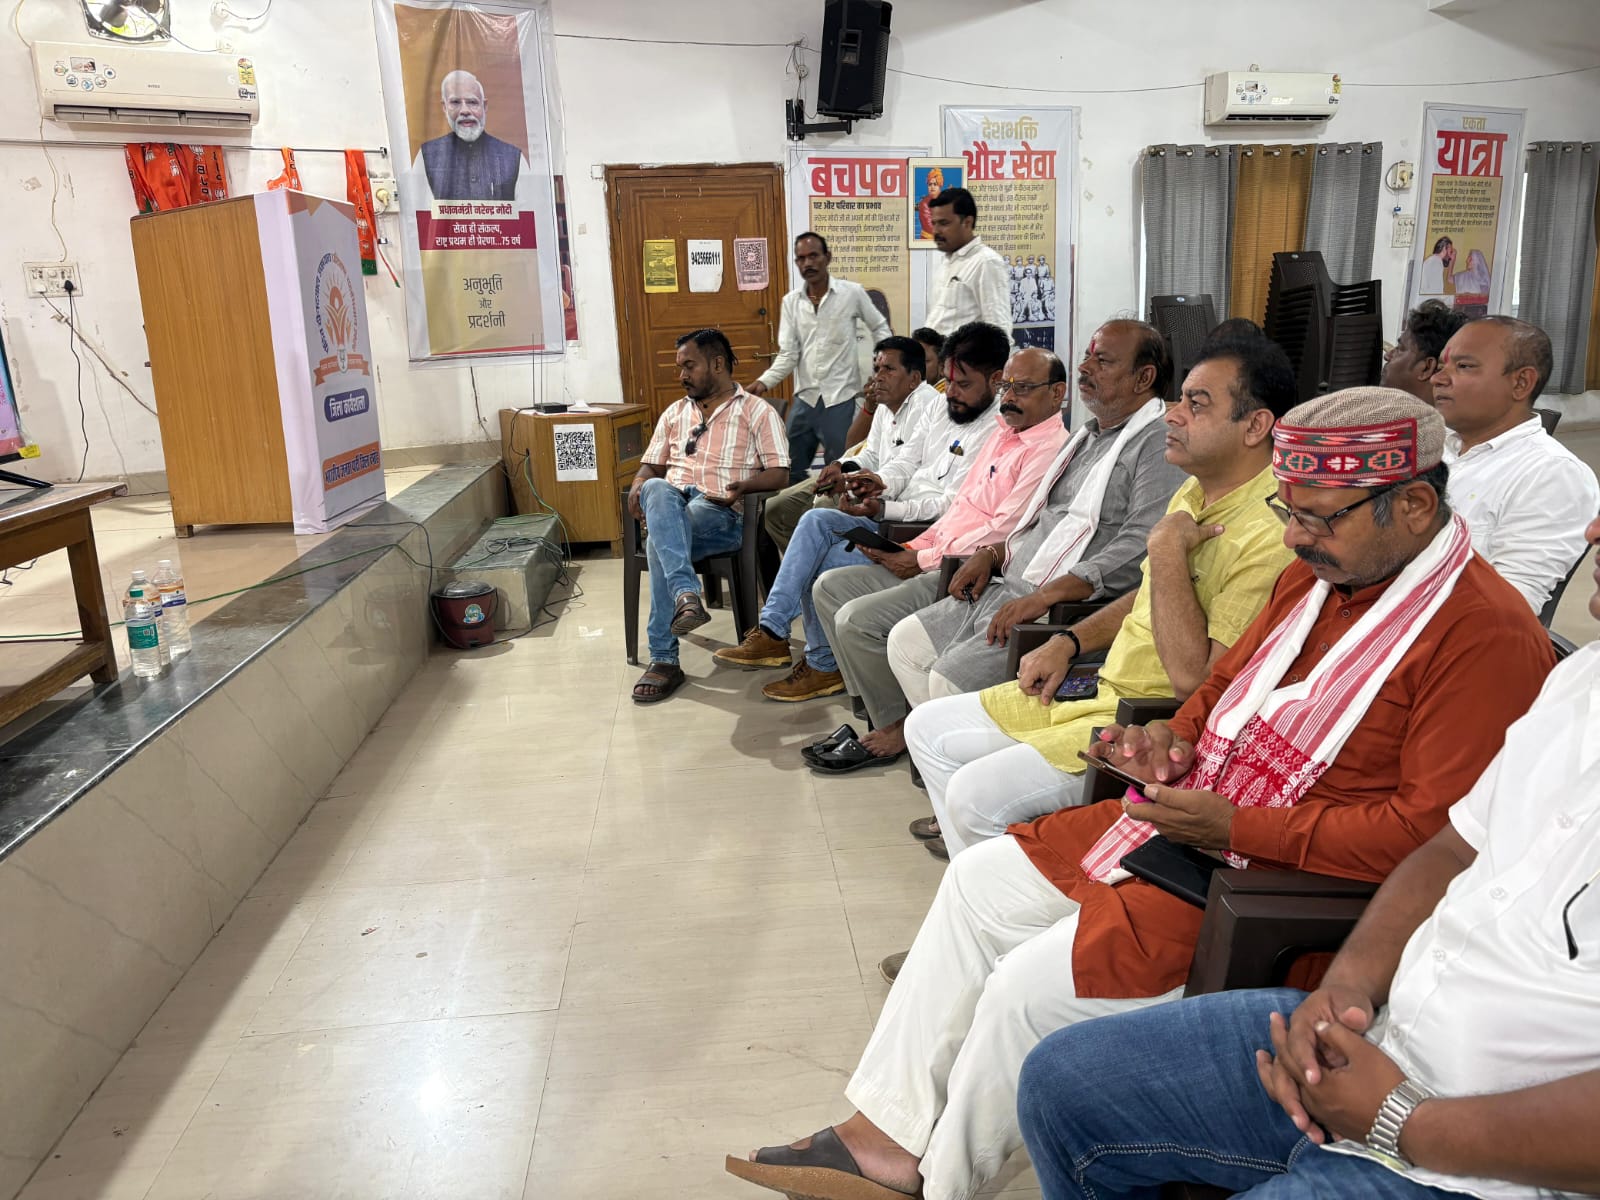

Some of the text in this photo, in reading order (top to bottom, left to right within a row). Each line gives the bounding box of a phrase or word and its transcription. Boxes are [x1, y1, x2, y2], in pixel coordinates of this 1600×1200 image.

[981, 115, 1039, 140] देशभक्ति
[962, 141, 1057, 180] और सेवा
[1436, 130, 1508, 176] यात्रा
[807, 157, 908, 197] बचपन
[439, 203, 512, 216] प्रधानमंत्री नरेन्द्र मोदी
[824, 200, 834, 210] और
[836, 200, 856, 210] परिवार
[452, 222, 502, 235] सेवा ही संकल्प,
[436, 236, 448, 248] राष्ट्र
[448, 236, 466, 246] प्रथम
[468, 234, 476, 246] ही
[511, 235, 521, 246] वर्ष
[691, 251, 721, 265] 9425666111
[463, 274, 503, 294] अनुभूति
[480, 298, 492, 308] और
[468, 310, 506, 328] प्रदर्शनी
[330, 394, 366, 418] जिला कार्यशाला
